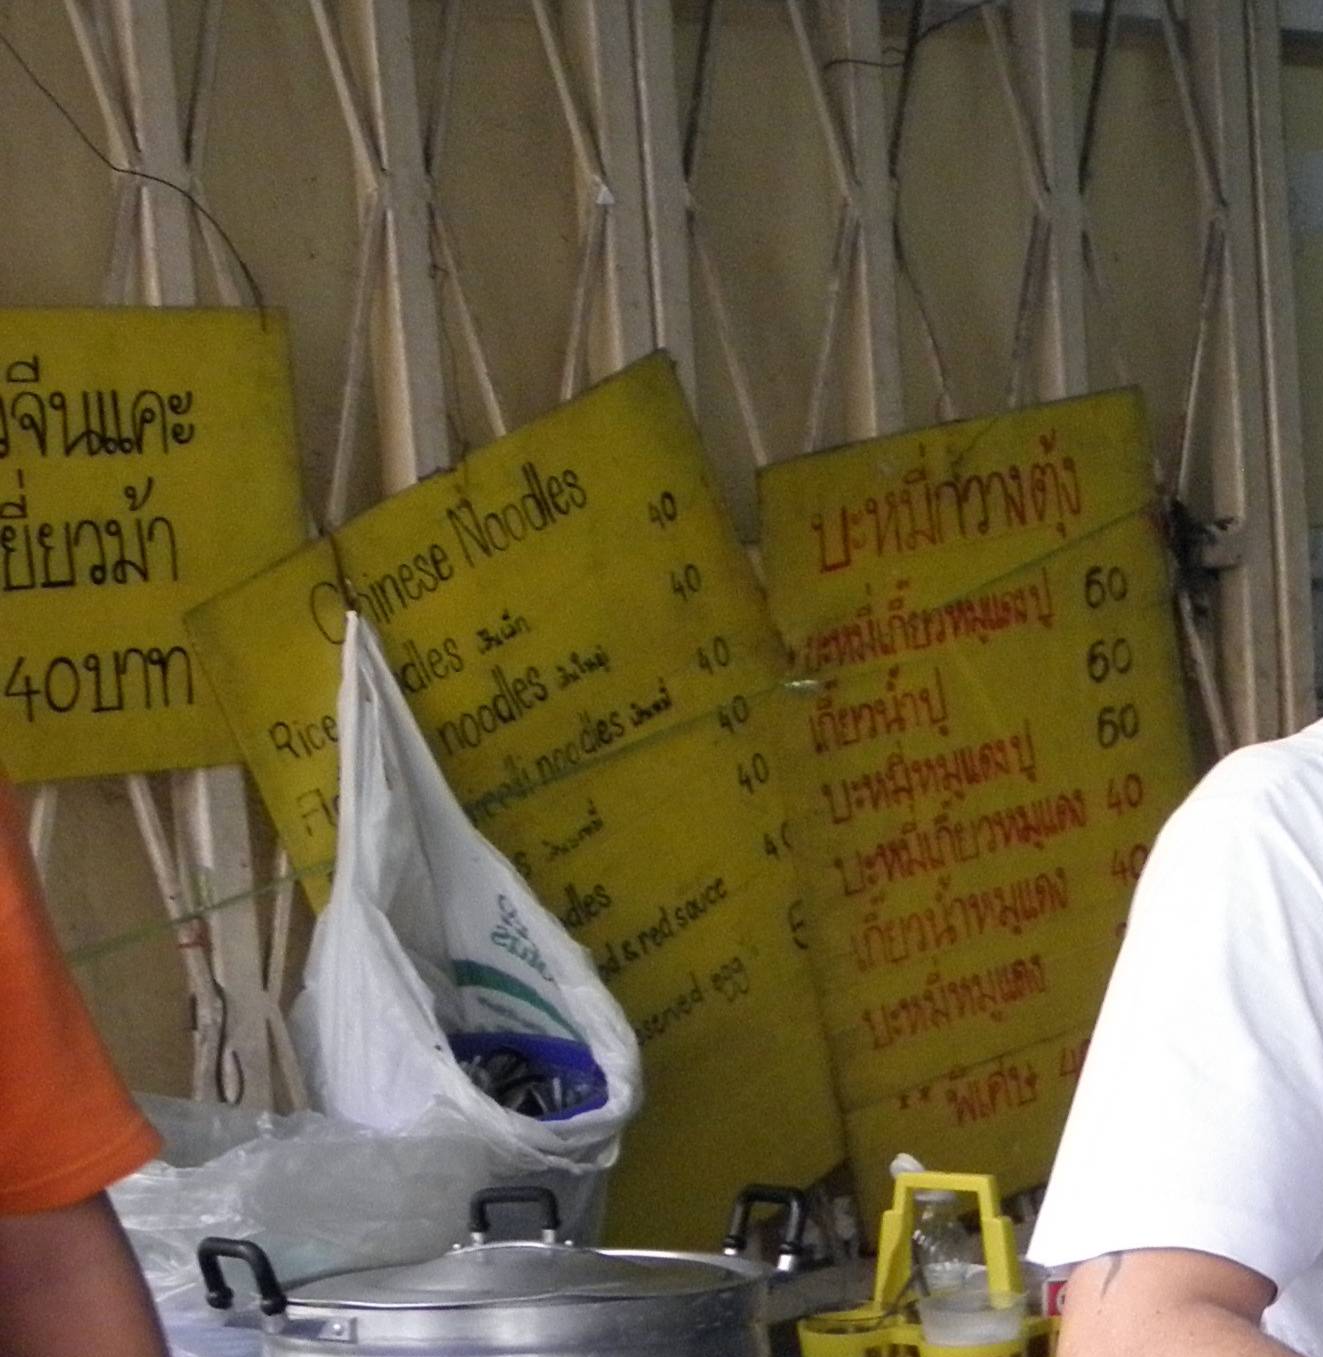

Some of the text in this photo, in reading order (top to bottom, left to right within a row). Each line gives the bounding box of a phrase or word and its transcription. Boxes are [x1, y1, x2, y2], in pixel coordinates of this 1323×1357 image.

[0, 355, 195, 458] จีนแคะ
[648, 490, 678, 530] 40
[310, 461, 588, 647] Chinese Noodles
[669, 564, 702, 602] 40
[1085, 566, 1127, 609] 60
[398, 637, 465, 693] dles
[696, 636, 730, 675] 40
[1087, 637, 1132, 683] 60
[437, 663, 550, 757] noodles
[719, 695, 750, 734] 40
[1097, 703, 1139, 749] 60
[737, 752, 770, 793] 40
[1106, 773, 1144, 817] 40
[562, 883, 613, 929] dles
